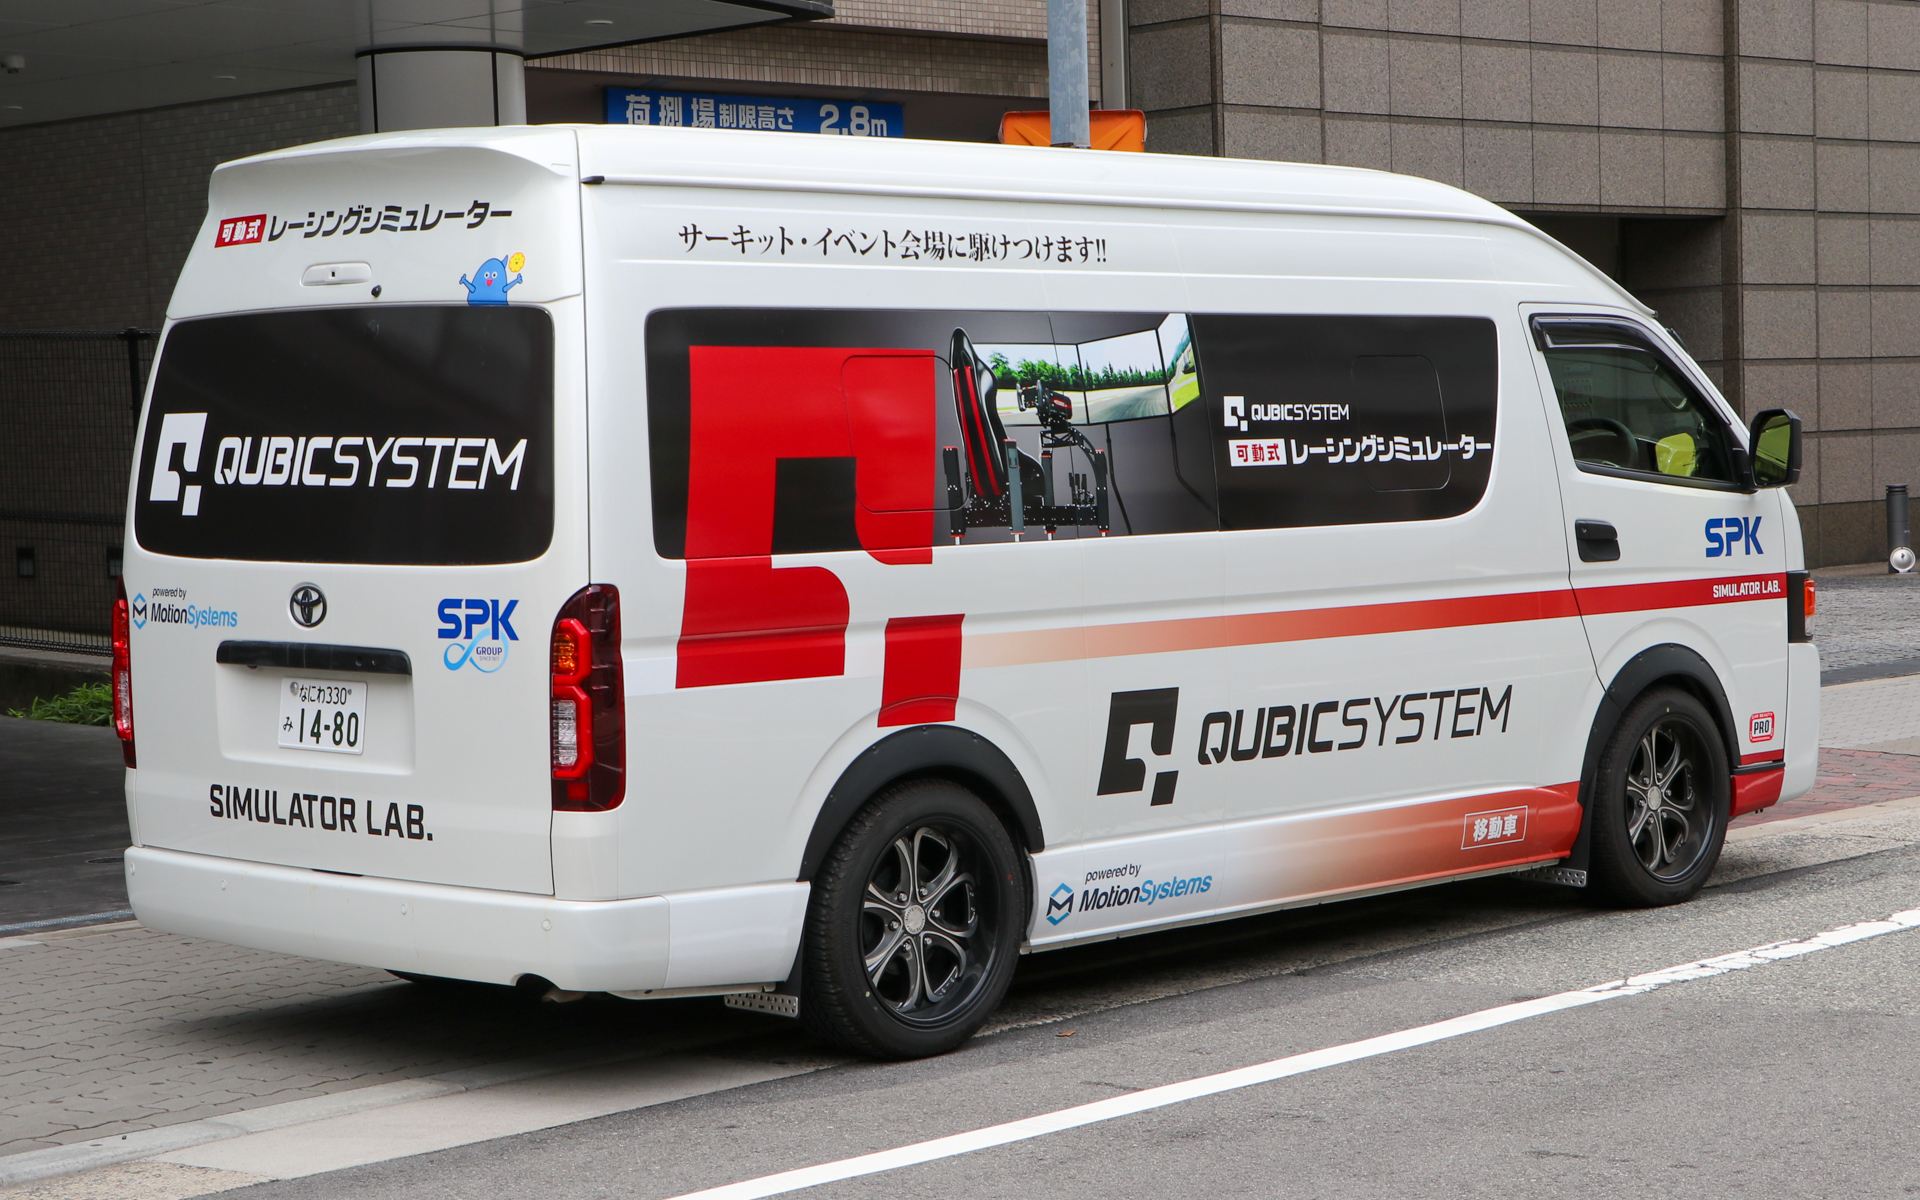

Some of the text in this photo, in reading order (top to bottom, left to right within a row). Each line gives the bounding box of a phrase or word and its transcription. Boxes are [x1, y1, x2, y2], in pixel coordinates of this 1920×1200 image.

[820, 103, 887, 136] 2.8m
[221, 200, 512, 243] 可動式 レーシングシミュレーター
[1251, 404, 1350, 421] QUBICSYSTEM
[214, 436, 528, 490] QUBICSYSTEM
[1236, 434, 1492, 465] 可動式 レーシングシミュレーター
[1705, 516, 1764, 558] SPK
[152, 587, 187, 600] powered by
[1713, 580, 1781, 598] SIMULATOR LAB.
[151, 603, 238, 629] MotionSystems
[437, 598, 520, 641] SPK
[476, 647, 502, 655] GROUP
[299, 708, 359, 747] 14-80
[1198, 684, 1513, 765] QUBICSYSTEM
[1753, 720, 1769, 735] PRO
[210, 783, 433, 841] SIMULATOR LAB.
[1473, 814, 1518, 842] 移動車
[1085, 864, 1141, 885] powered by
[1078, 875, 1212, 912] MotionSystems
